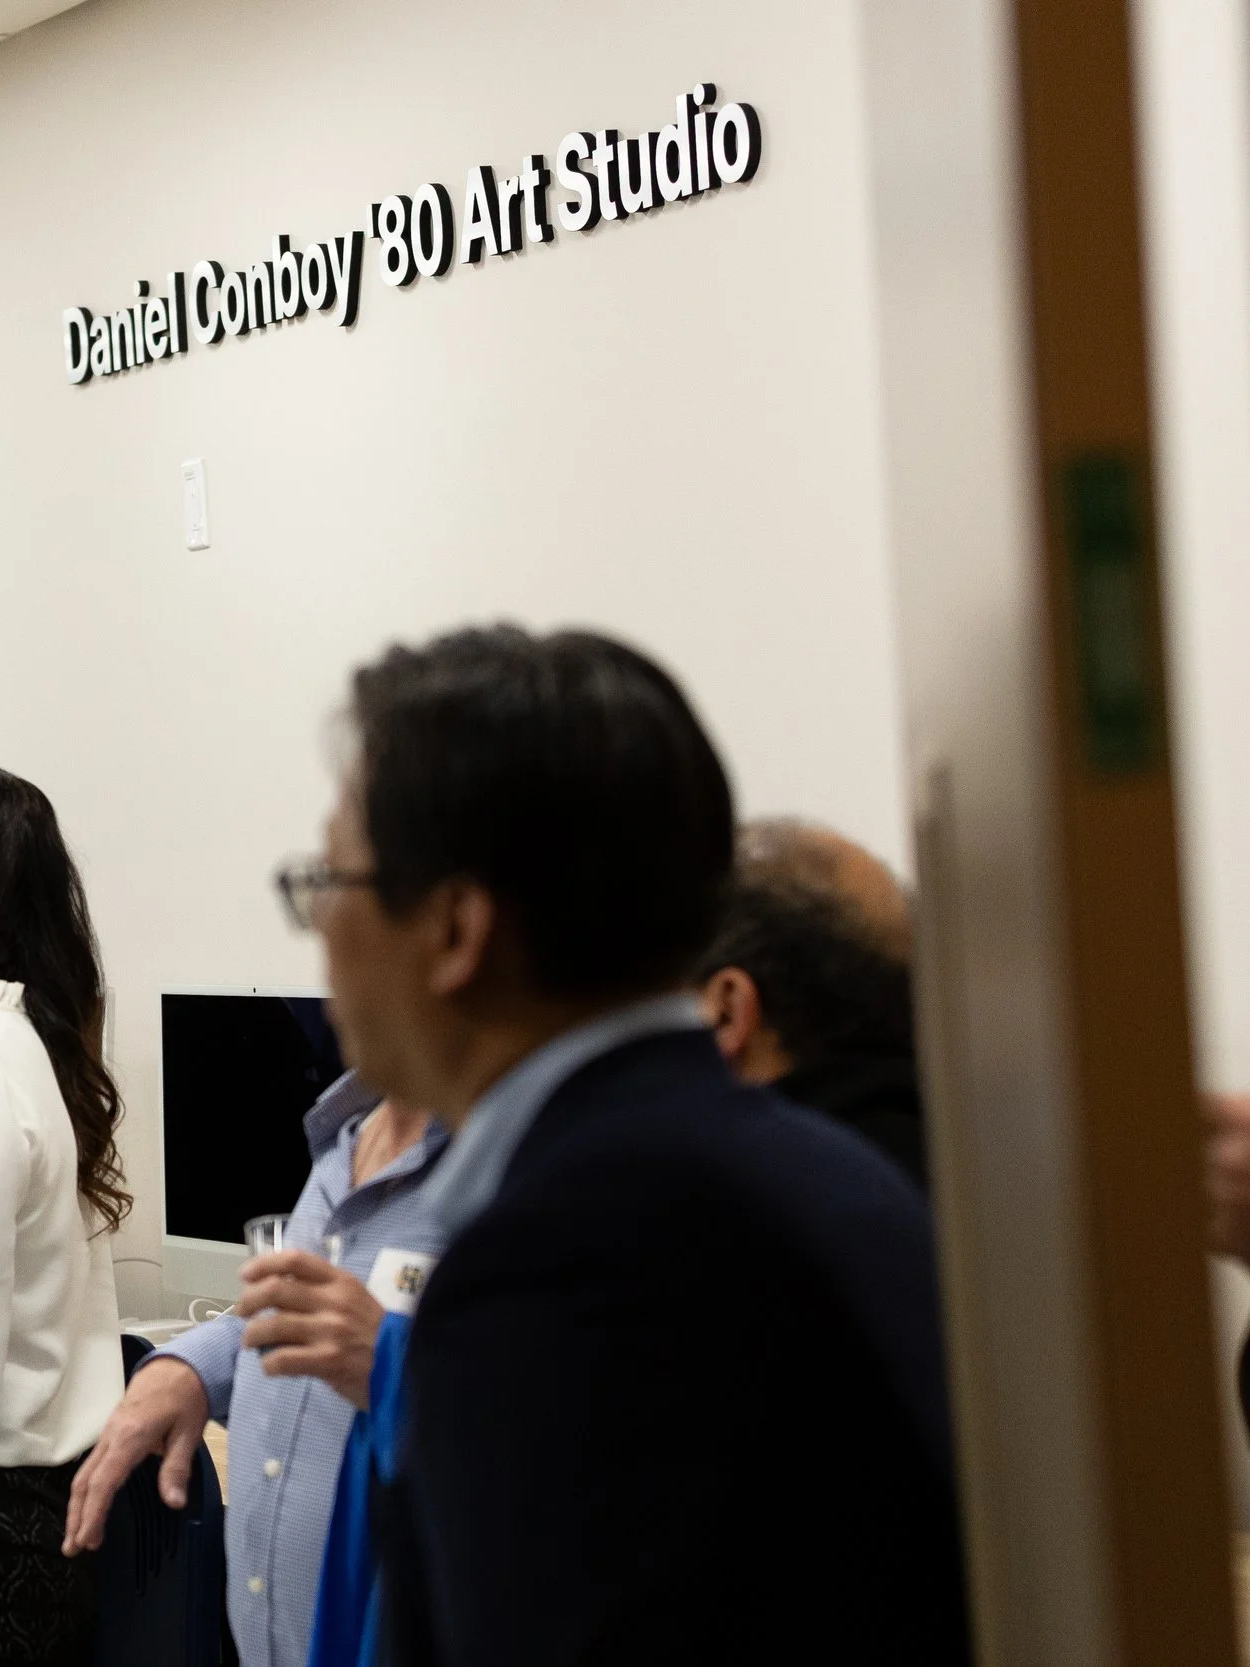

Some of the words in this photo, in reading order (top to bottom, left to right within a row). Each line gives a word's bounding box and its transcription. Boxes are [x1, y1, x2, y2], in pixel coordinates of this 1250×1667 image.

[63, 271, 187, 385] Daniel
[190, 230, 364, 344] Conboy
[461, 154, 554, 264] Art
[557, 83, 761, 232] Studio
